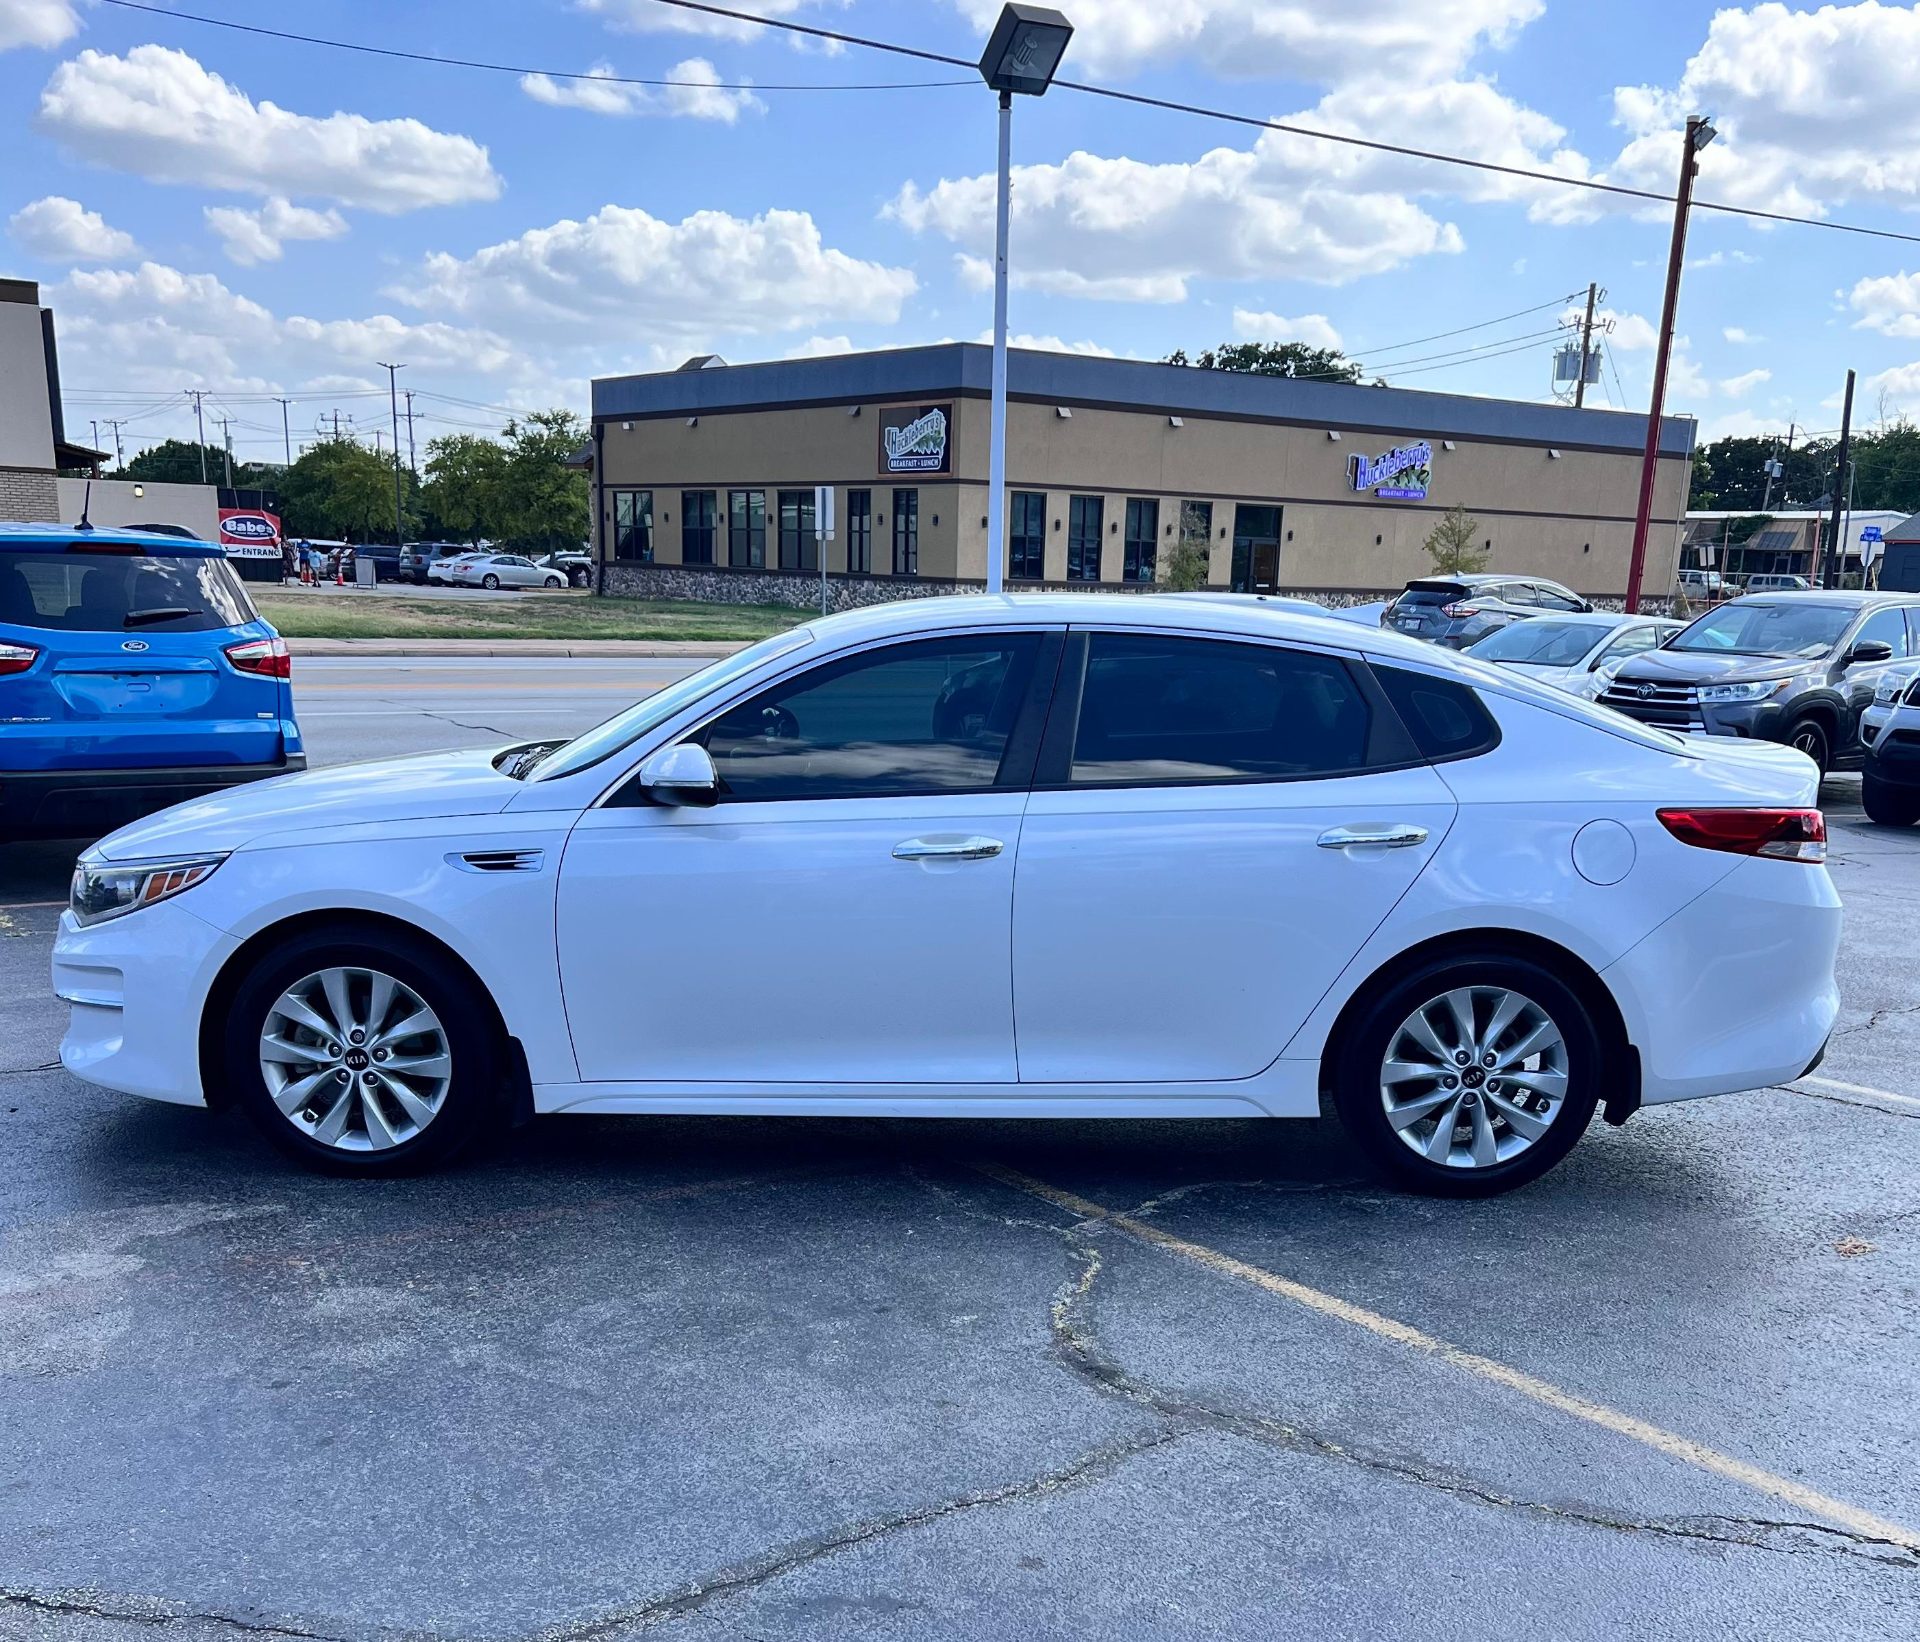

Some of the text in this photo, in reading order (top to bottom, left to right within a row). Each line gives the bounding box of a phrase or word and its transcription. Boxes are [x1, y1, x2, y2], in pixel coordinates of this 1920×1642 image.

[890, 458, 939, 468] BREAKFAST LUNCH
[1356, 442, 1432, 491] Huckleberry's
[1379, 488, 1424, 498] BREAKFAST LUNCH
[242, 547, 280, 557] ENTRANC
[346, 1055, 367, 1065] KIA
[1463, 1071, 1484, 1085] KIA
